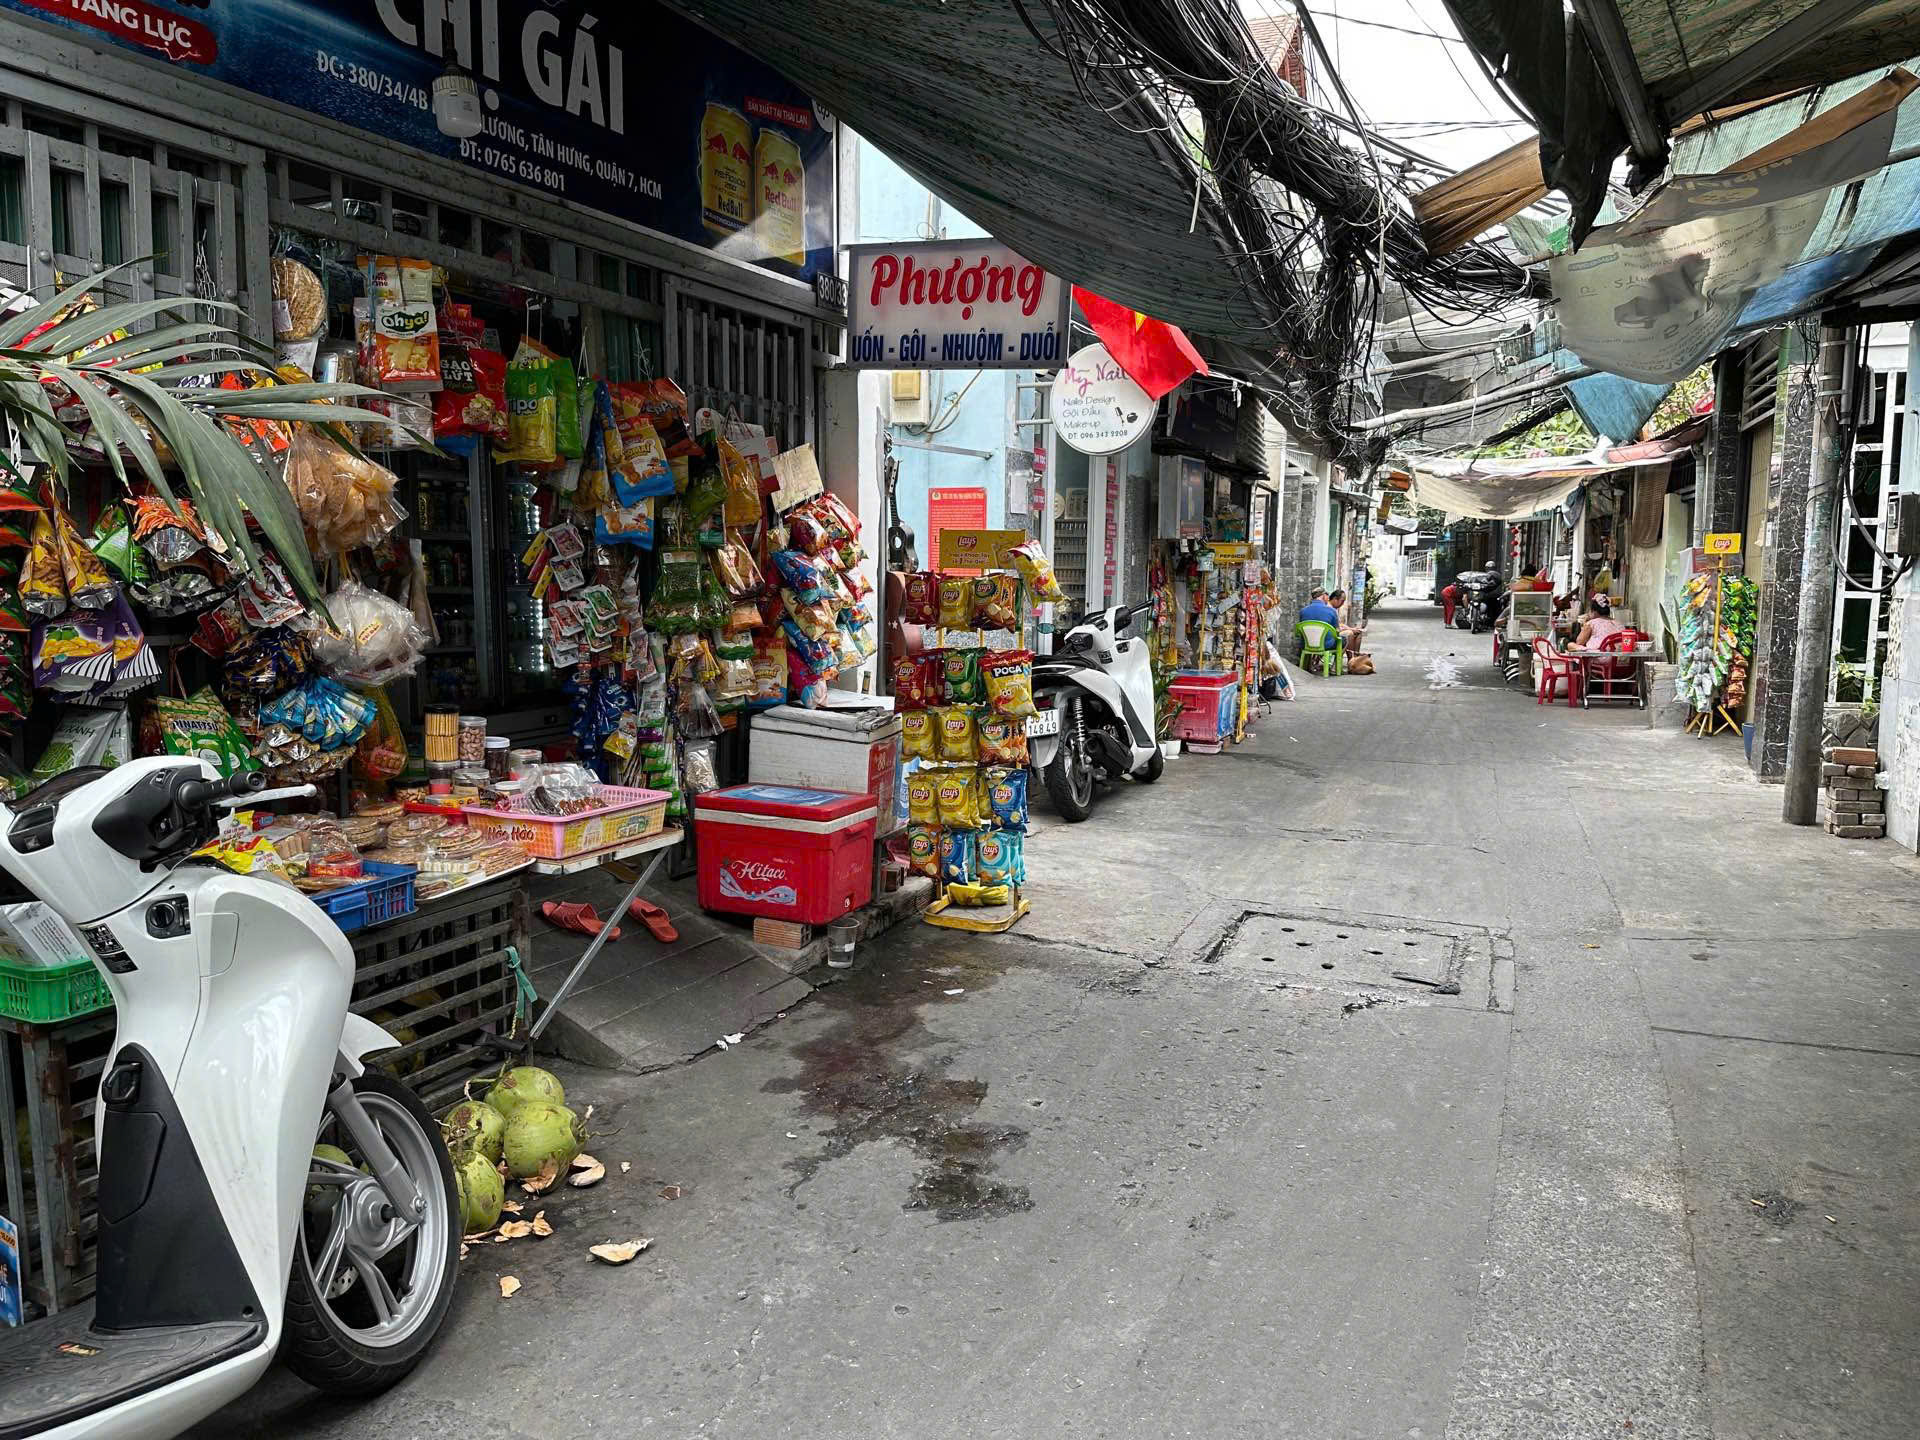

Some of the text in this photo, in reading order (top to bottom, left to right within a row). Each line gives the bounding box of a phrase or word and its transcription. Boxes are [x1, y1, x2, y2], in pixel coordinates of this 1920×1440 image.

[144, 14, 192, 47] LỰC
[521, 13, 624, 135] GÁI
[316, 49, 345, 80] ĐC:
[347, 61, 429, 111] 380/34/4B
[530, 133, 554, 160] TÂN
[556, 143, 594, 177] HƯNG,
[595, 159, 626, 188] QUẬN
[627, 171, 638, 193] 7,
[639, 175, 663, 201] HCM
[460, 136, 565, 192] ĐT: 0765 636 801
[819, 275, 848, 307] 380/33
[870, 254, 1047, 320] Phượng
[852, 326, 884, 362] UỐN
[1020, 321, 1061, 361] DUỖI
[1085, 395, 1116, 407] Design
[1080, 431, 1094, 439] 096
[993, 665, 1023, 678] POCA
